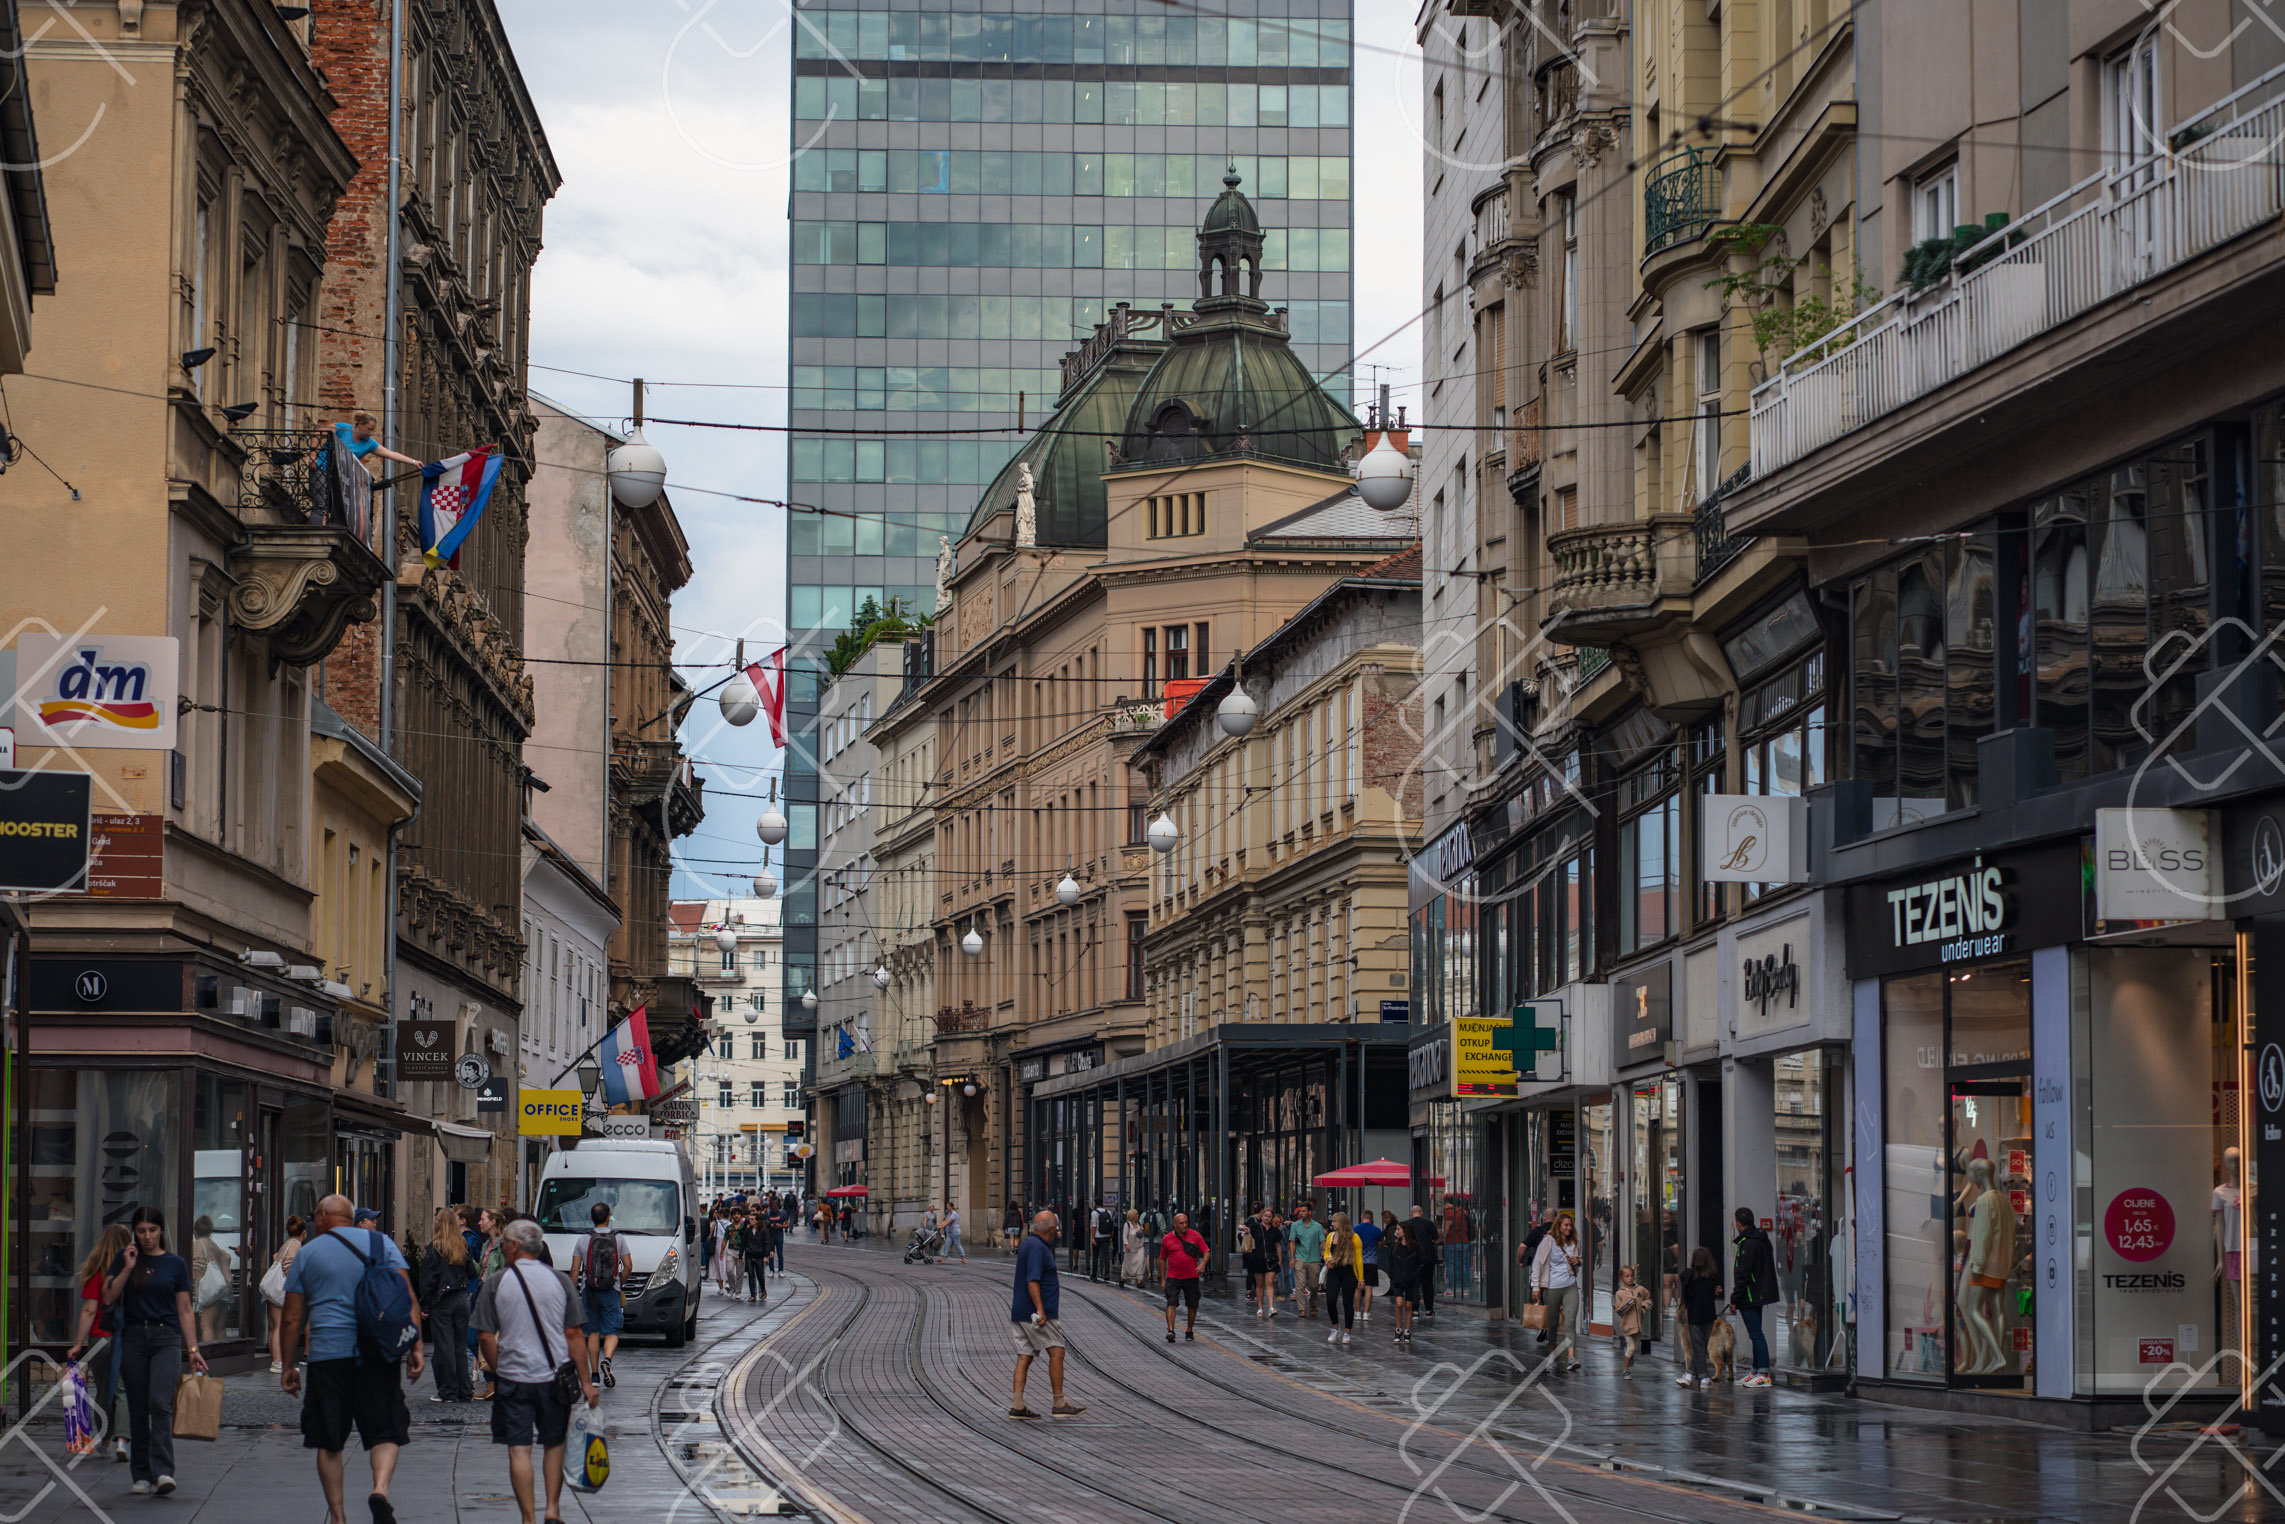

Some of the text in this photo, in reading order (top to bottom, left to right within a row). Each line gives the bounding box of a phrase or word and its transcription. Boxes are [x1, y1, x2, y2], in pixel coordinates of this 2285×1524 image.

[59, 651, 146, 700] dm
[110, 817, 125, 825] ulaz
[1438, 820, 1472, 881] terranov
[1941, 934, 2005, 962] underwear
[83, 976, 100, 995] M
[1460, 1039, 1490, 1047] OTKUP
[403, 1052, 448, 1061] VINCEK
[1465, 1052, 1512, 1061] EXCHANGE
[1023, 1062, 1039, 1079] roberto
[2038, 1077, 2064, 1105] follow
[524, 1104, 579, 1116] OFFICE
[663, 1101, 691, 1110] SALON
[605, 1124, 645, 1135] ecco
[2046, 1121, 2055, 1139] us
[2124, 1199, 2156, 1208] CIJENE
[2124, 1219, 2152, 1233] 1,65
[2118, 1235, 2154, 1250] 12,43
[2143, 1346, 2170, 1356] -20%
